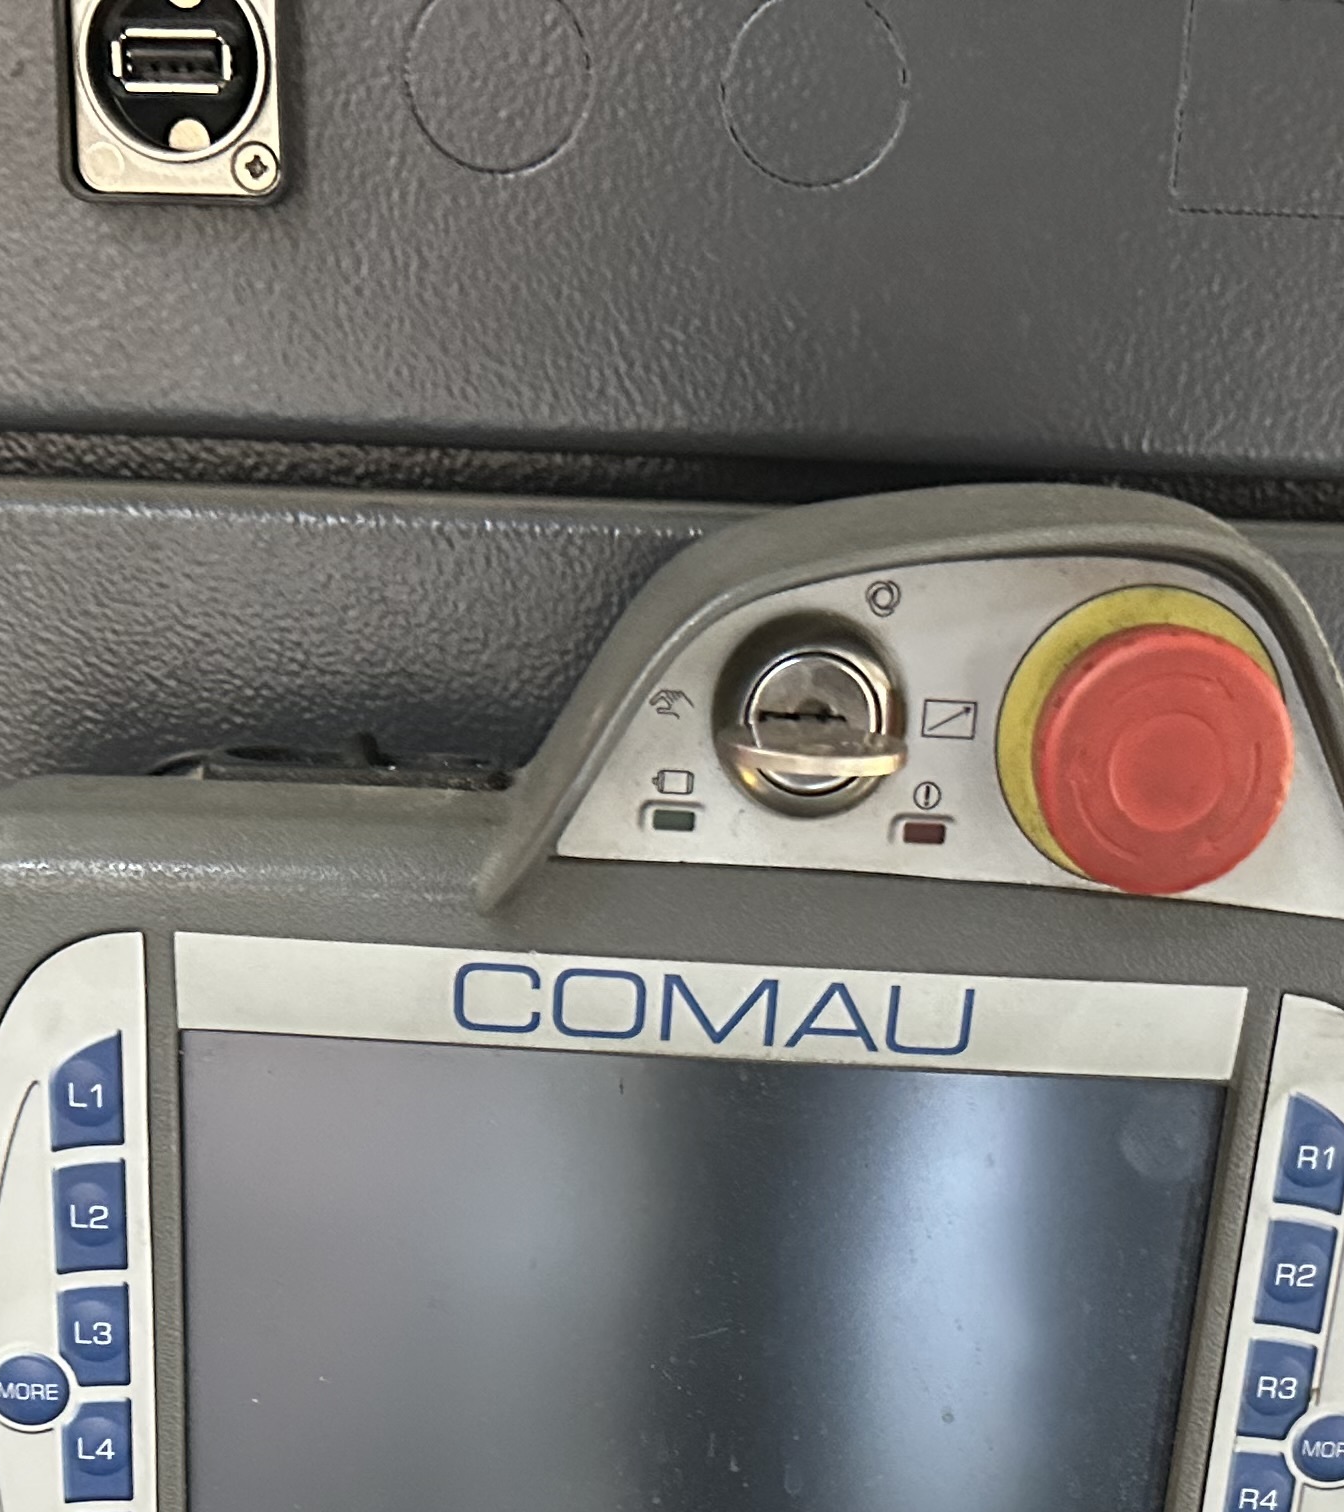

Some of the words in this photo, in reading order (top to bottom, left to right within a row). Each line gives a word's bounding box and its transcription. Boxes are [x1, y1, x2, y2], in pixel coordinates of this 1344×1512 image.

[453, 963, 976, 1055] COMAU
[68, 1083, 103, 1108] L1
[1296, 1146, 1336, 1170] R1
[70, 1204, 109, 1229] L2
[1274, 1263, 1317, 1288] R2
[73, 1321, 113, 1345] L3
[1256, 1375, 1298, 1400] R3
[77, 1437, 116, 1460] L4
[1238, 1488, 1278, 1511] R4
